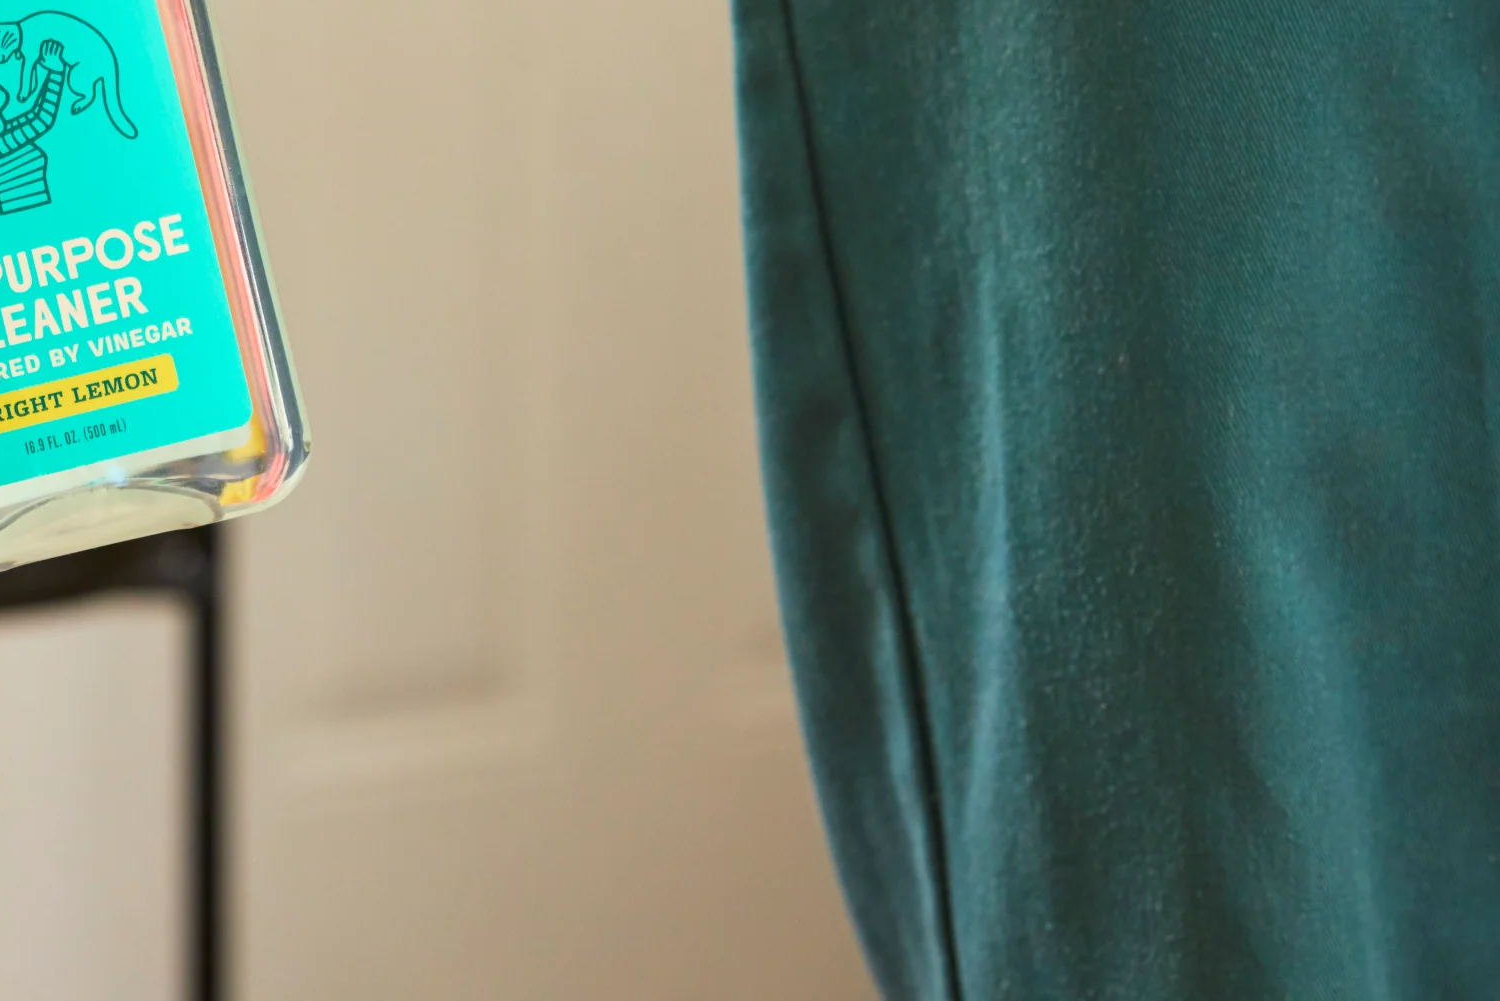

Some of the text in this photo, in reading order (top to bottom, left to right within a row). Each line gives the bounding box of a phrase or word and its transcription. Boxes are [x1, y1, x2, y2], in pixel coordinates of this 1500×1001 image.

[49, 344, 79, 368] BY
[87, 317, 193, 357] VINEGAR
[73, 368, 159, 403] LEMON
[24, 417, 127, 455] 16.9 FL. OZ. (500 mL)
